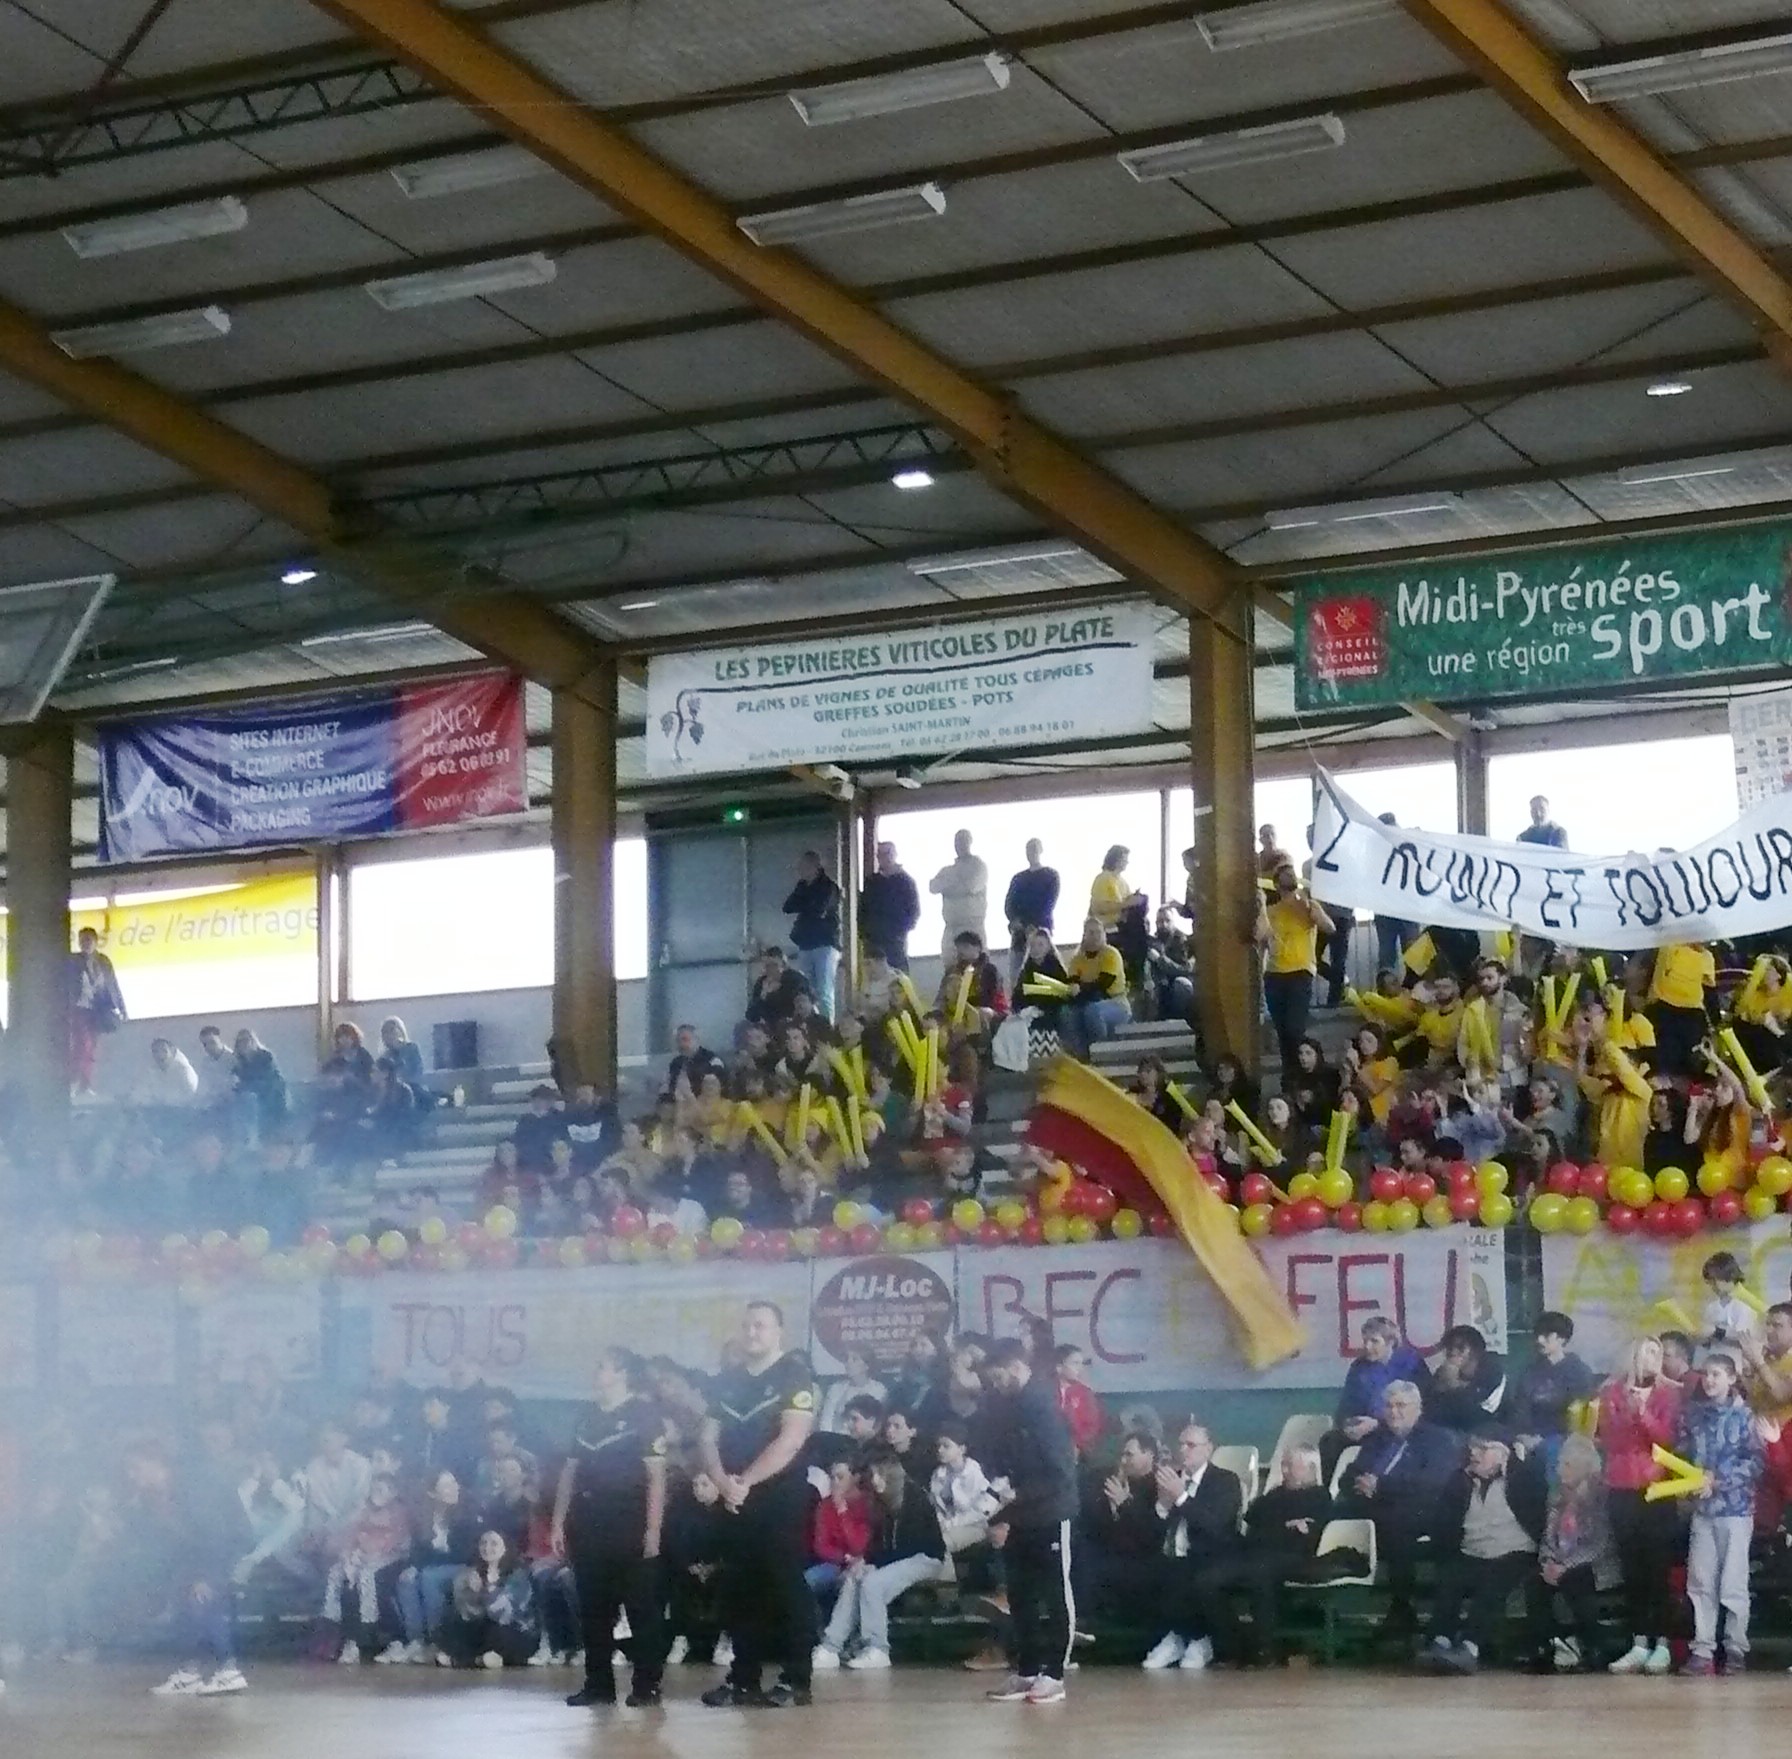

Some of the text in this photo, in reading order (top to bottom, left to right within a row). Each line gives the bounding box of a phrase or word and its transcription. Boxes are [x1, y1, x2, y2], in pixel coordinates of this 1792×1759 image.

[1397, 559, 1681, 627] Midi-Pyrénées
[1317, 637, 1378, 651] CONSEIL
[1552, 582, 1773, 675] très sport
[715, 616, 1114, 681] LES PEPINIERES VITICOLES DU PLATE
[1428, 637, 1570, 676] une région
[790, 695, 809, 708] DE
[815, 689, 870, 706] VIGNES
[876, 686, 896, 700] DE
[974, 671, 1018, 688] TOUS
[814, 704, 880, 722] GREFFES
[972, 690, 1014, 707] POTS
[229, 721, 341, 751] SITES INTERNET
[892, 715, 972, 733] SAINT-MARTIN
[303, 771, 388, 798] GRAPHIQUE
[1540, 868, 1586, 929] ET
[118, 916, 157, 947] de
[165, 905, 319, 944] l'arbitrage
